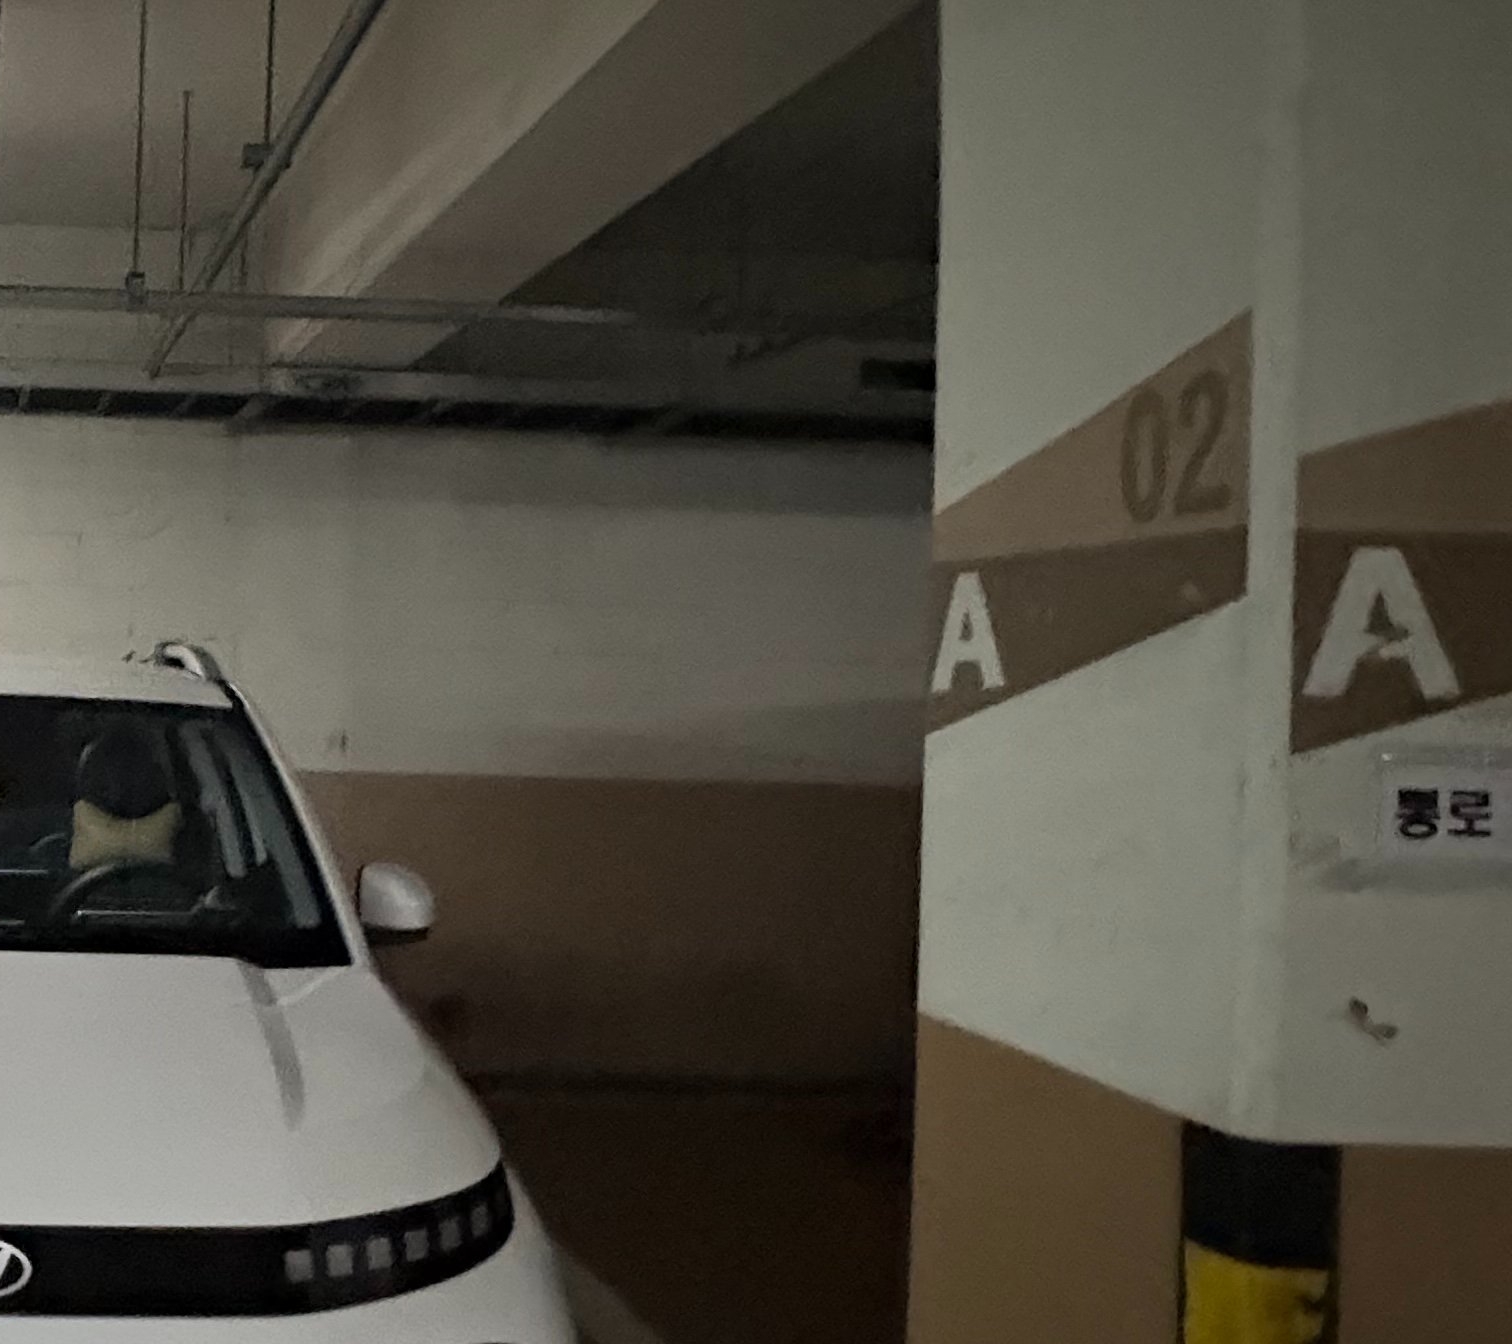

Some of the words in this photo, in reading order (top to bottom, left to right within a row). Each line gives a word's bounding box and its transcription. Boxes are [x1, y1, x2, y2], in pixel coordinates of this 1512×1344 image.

[1120, 369, 1233, 524] 02
[931, 571, 1005, 695] A
[1301, 545, 1462, 700] A
